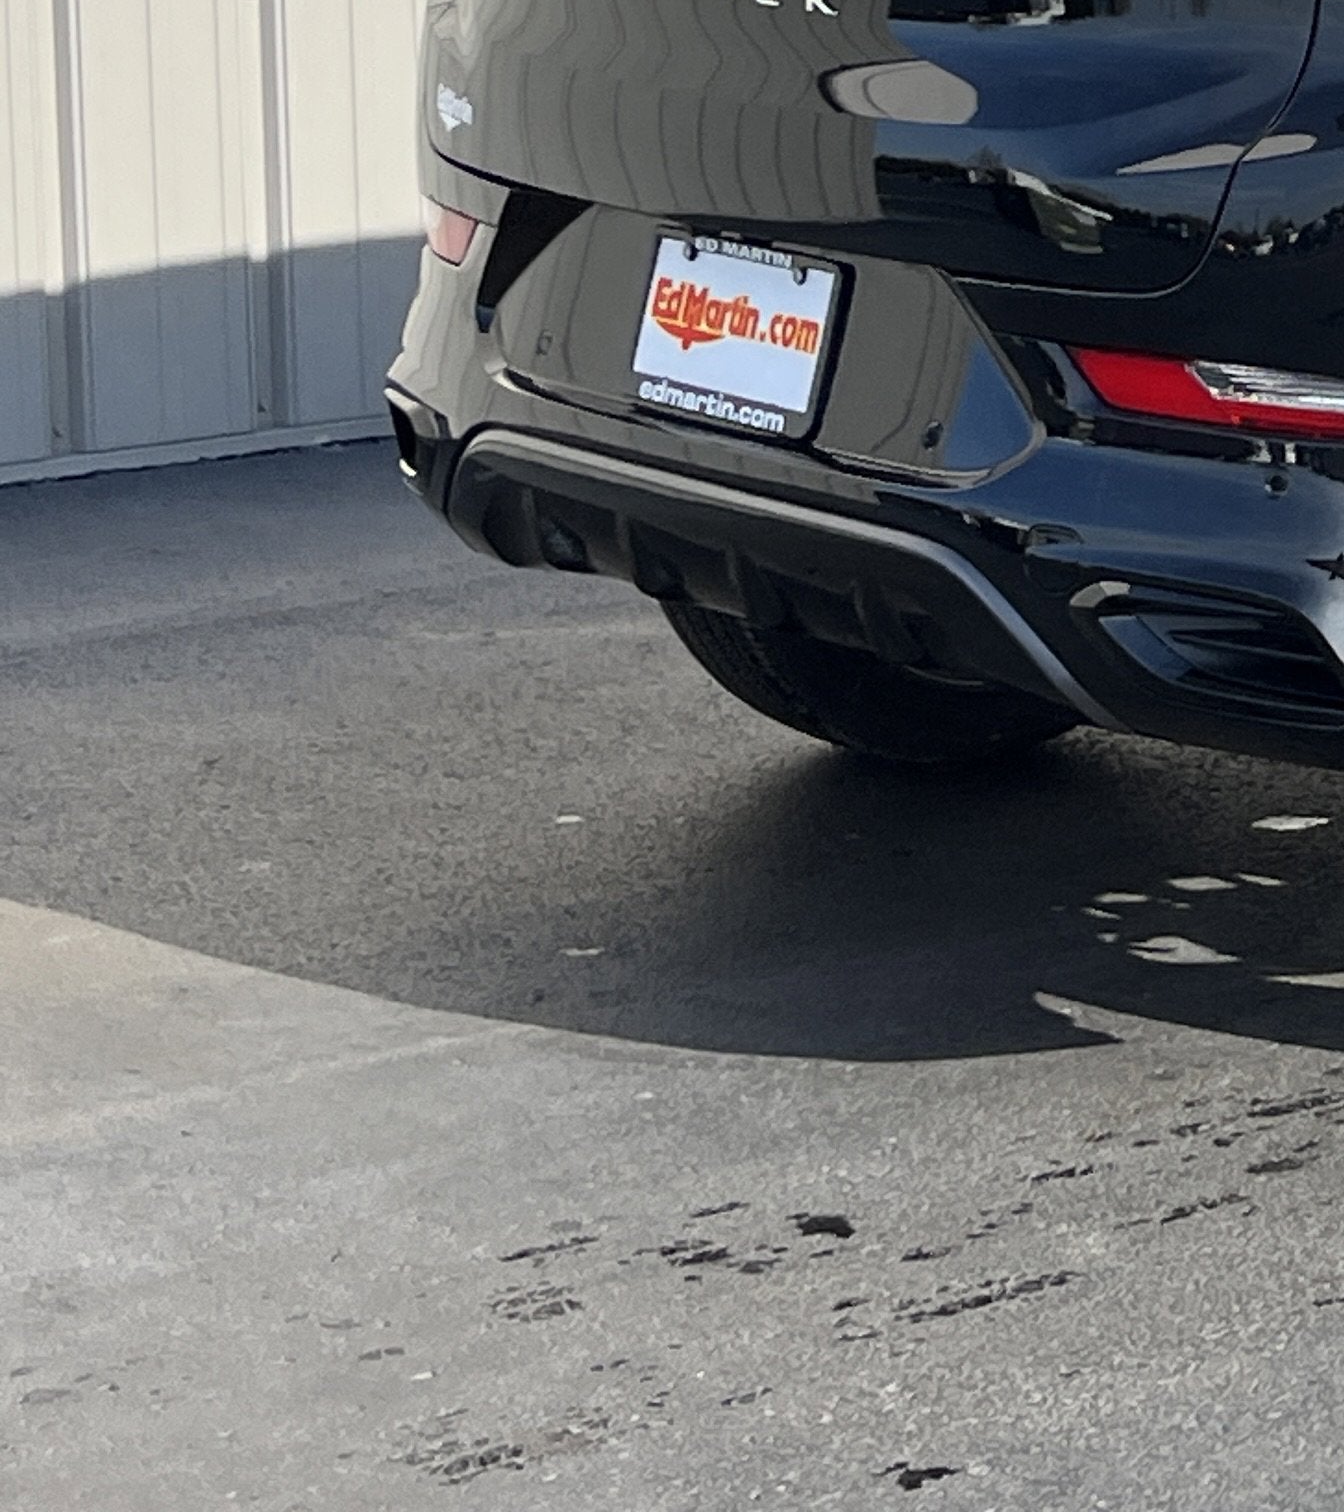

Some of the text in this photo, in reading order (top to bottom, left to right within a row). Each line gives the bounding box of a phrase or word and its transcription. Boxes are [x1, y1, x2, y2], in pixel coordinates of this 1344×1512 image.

[722, 241, 792, 268] MARTIN
[652, 277, 820, 354] EdMartin.com
[638, 380, 786, 433] edmartin.com
